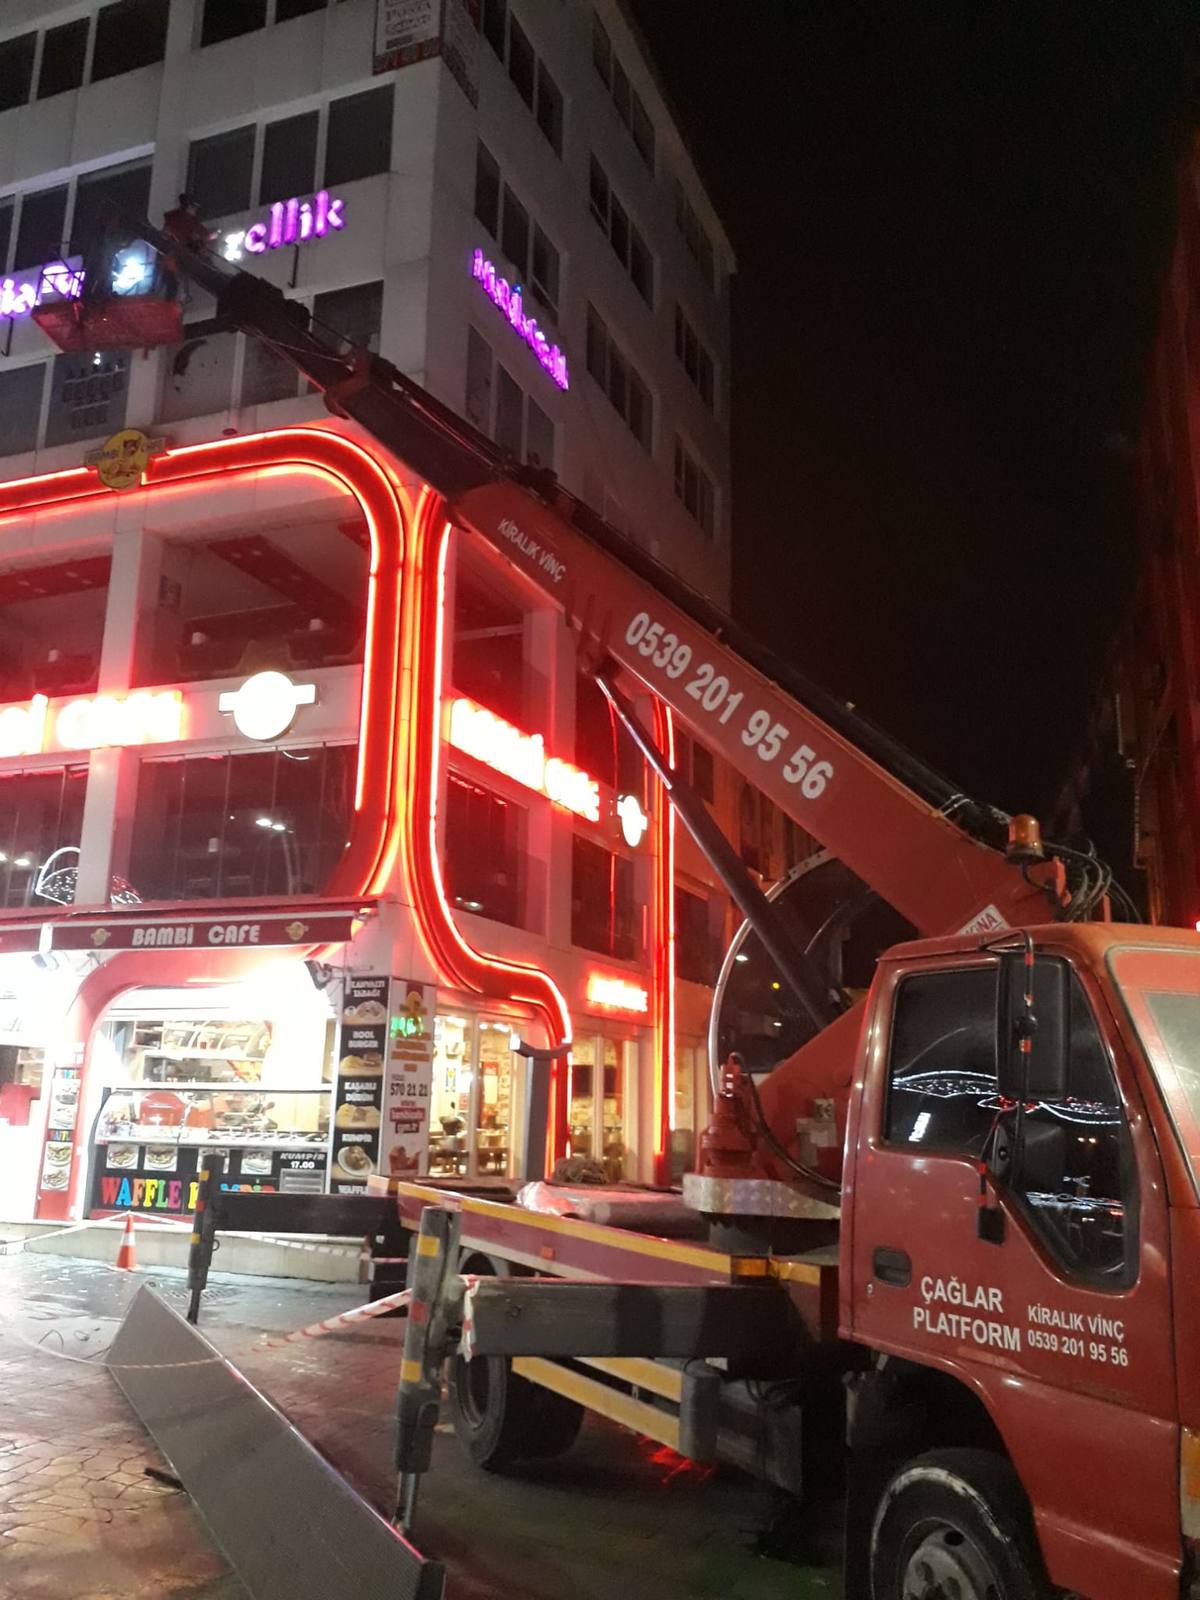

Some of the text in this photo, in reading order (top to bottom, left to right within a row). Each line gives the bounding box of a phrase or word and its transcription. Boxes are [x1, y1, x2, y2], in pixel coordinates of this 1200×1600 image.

[538, 553, 566, 582] VİNÇ
[626, 612, 833, 799] 0539 201 95 56
[208, 924, 261, 943] CAFE
[390, 1082, 428, 1097] 570 21 21
[290, 1160, 315, 1170] 17.00
[101, 1177, 182, 1208] WAFFLE
[921, 1276, 1003, 1313] ÇAĞLAR
[913, 1306, 1021, 1352] PLATFORM
[1027, 1303, 1125, 1343] KİRALIK VİNÇ
[1027, 1330, 1129, 1367] 0539 201 95 56
